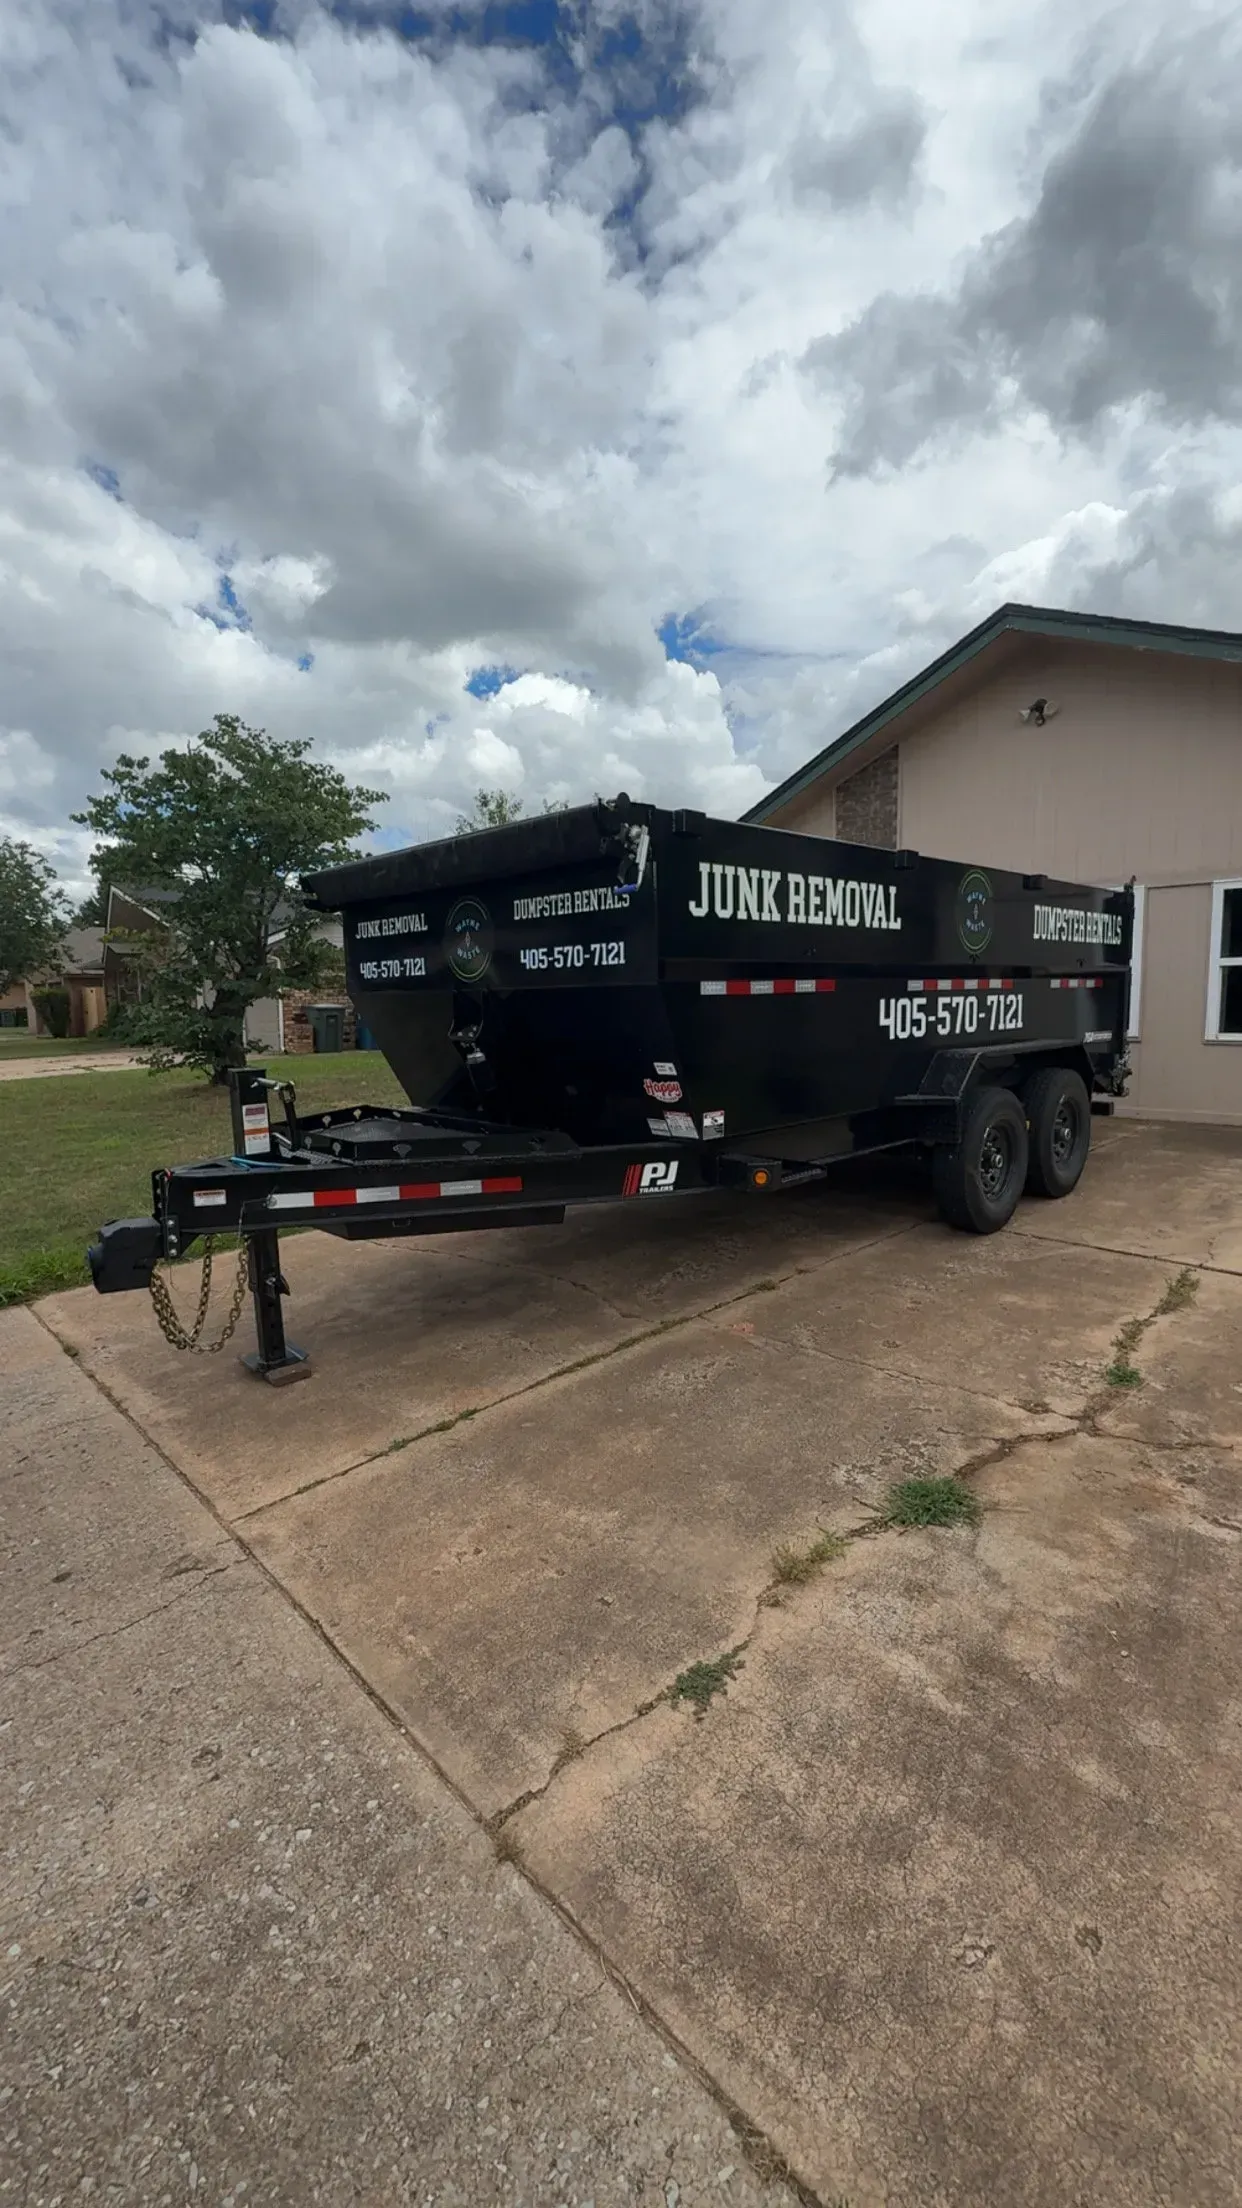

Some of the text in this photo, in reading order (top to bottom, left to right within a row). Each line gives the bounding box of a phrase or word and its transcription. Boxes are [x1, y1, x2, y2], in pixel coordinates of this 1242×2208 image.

[514, 885, 630, 920] DUMPSTER RENTALS
[687, 861, 901, 930] JUNK REMOVAL
[355, 913, 428, 939] JUNK REMOVAL
[1033, 904, 1122, 945] DUMPSTER RENTALS
[360, 957, 426, 979] 405-570-7121
[520, 941, 626, 969] 405-570-7121
[879, 994, 1024, 1040] 405-570-7121
[644, 1079, 681, 1097] Happy
[640, 1160, 679, 1187] PJ
[639, 1185, 674, 1194] TRAILERS
